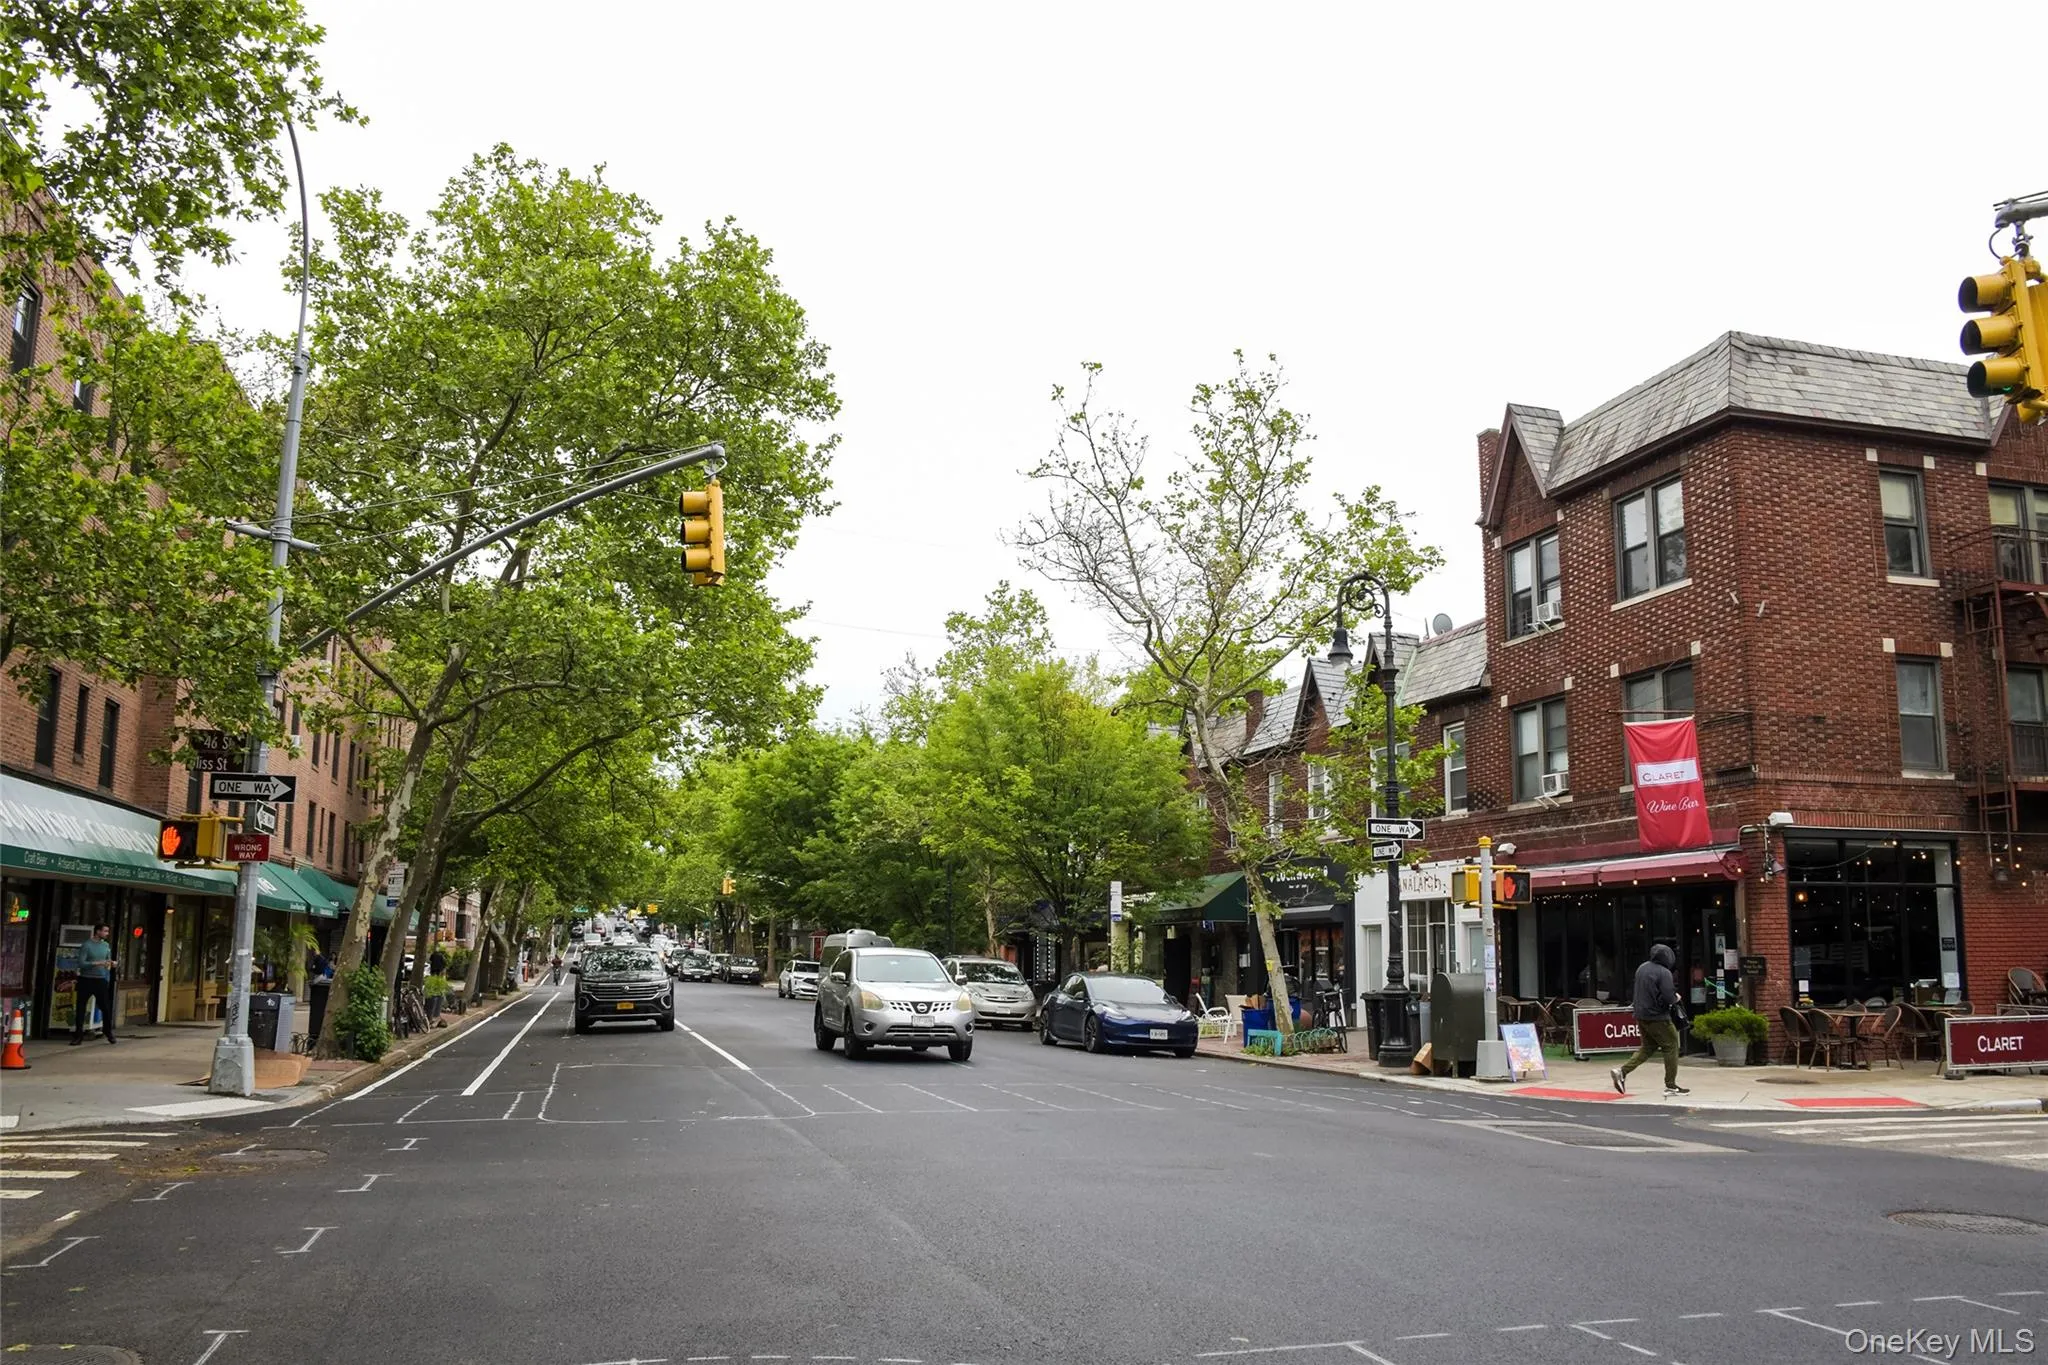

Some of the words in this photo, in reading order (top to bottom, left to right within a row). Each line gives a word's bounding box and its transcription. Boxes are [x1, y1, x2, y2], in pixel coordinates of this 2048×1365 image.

[216, 757, 228, 771] St
[1642, 770, 1685, 782] CLARET
[218, 781, 242, 793] ONE
[253, 782, 279, 794] WAY
[1646, 799, 1677, 813] Wine
[1679, 796, 1699, 811] Bar
[1375, 824, 1392, 833] ONE
[1399, 825, 1416, 834] WAY
[234, 843, 262, 852] WRONG
[1375, 848, 1385, 857] ONE
[239, 851, 257, 859] WAY
[1604, 1023, 1642, 1039] CLARE
[1977, 1035, 2024, 1053] CLARET
